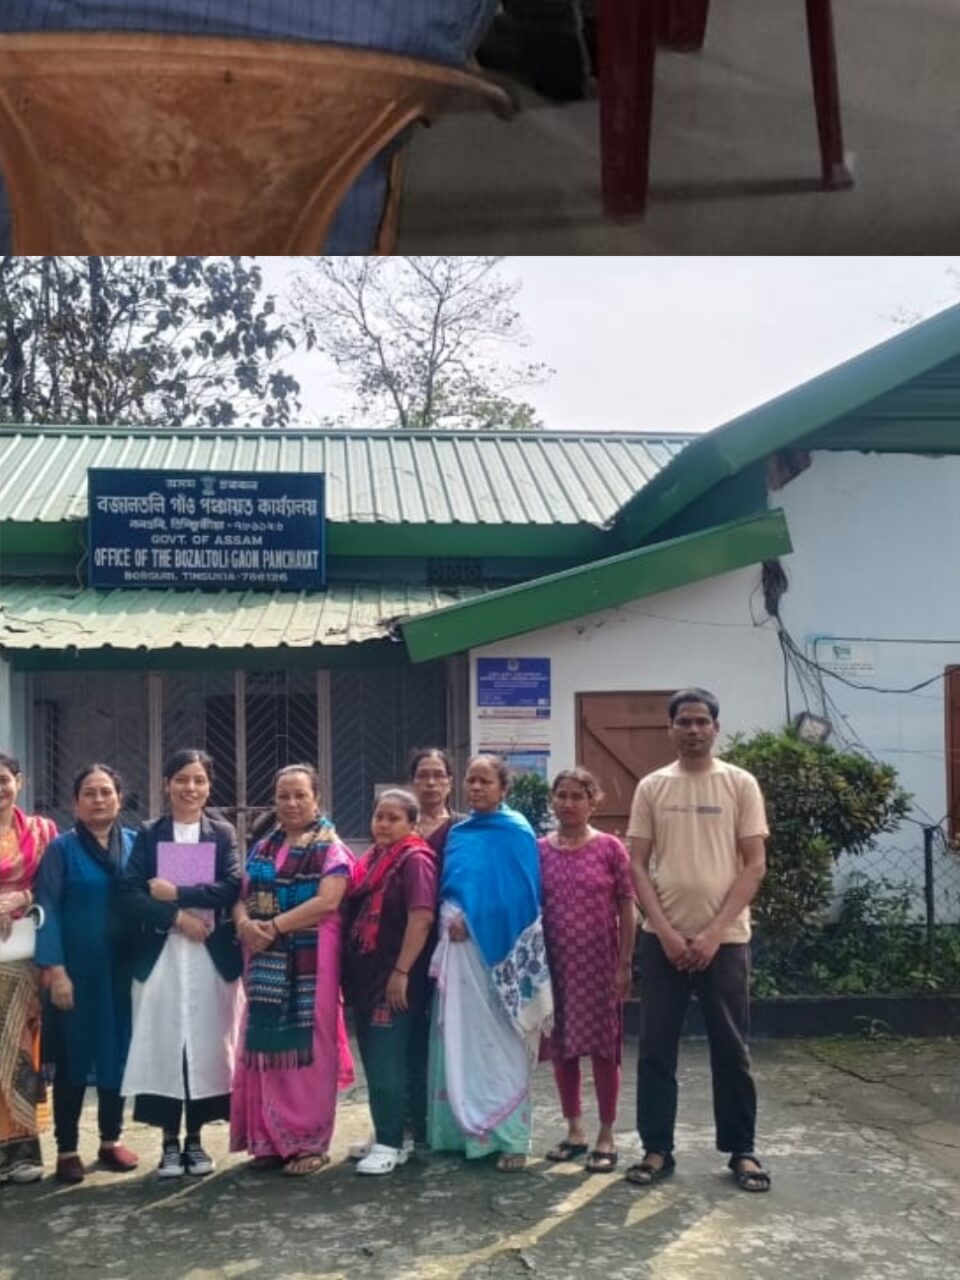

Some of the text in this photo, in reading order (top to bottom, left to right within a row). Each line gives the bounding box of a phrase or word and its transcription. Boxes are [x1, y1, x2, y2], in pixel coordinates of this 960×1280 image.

[151, 535, 263, 546] GOVT. OF ASSAM
[95, 548, 130, 567] OFFICE
[134, 549, 148, 567] OF
[152, 549, 171, 568] THE
[263, 550, 319, 570] PANCHAYAT
